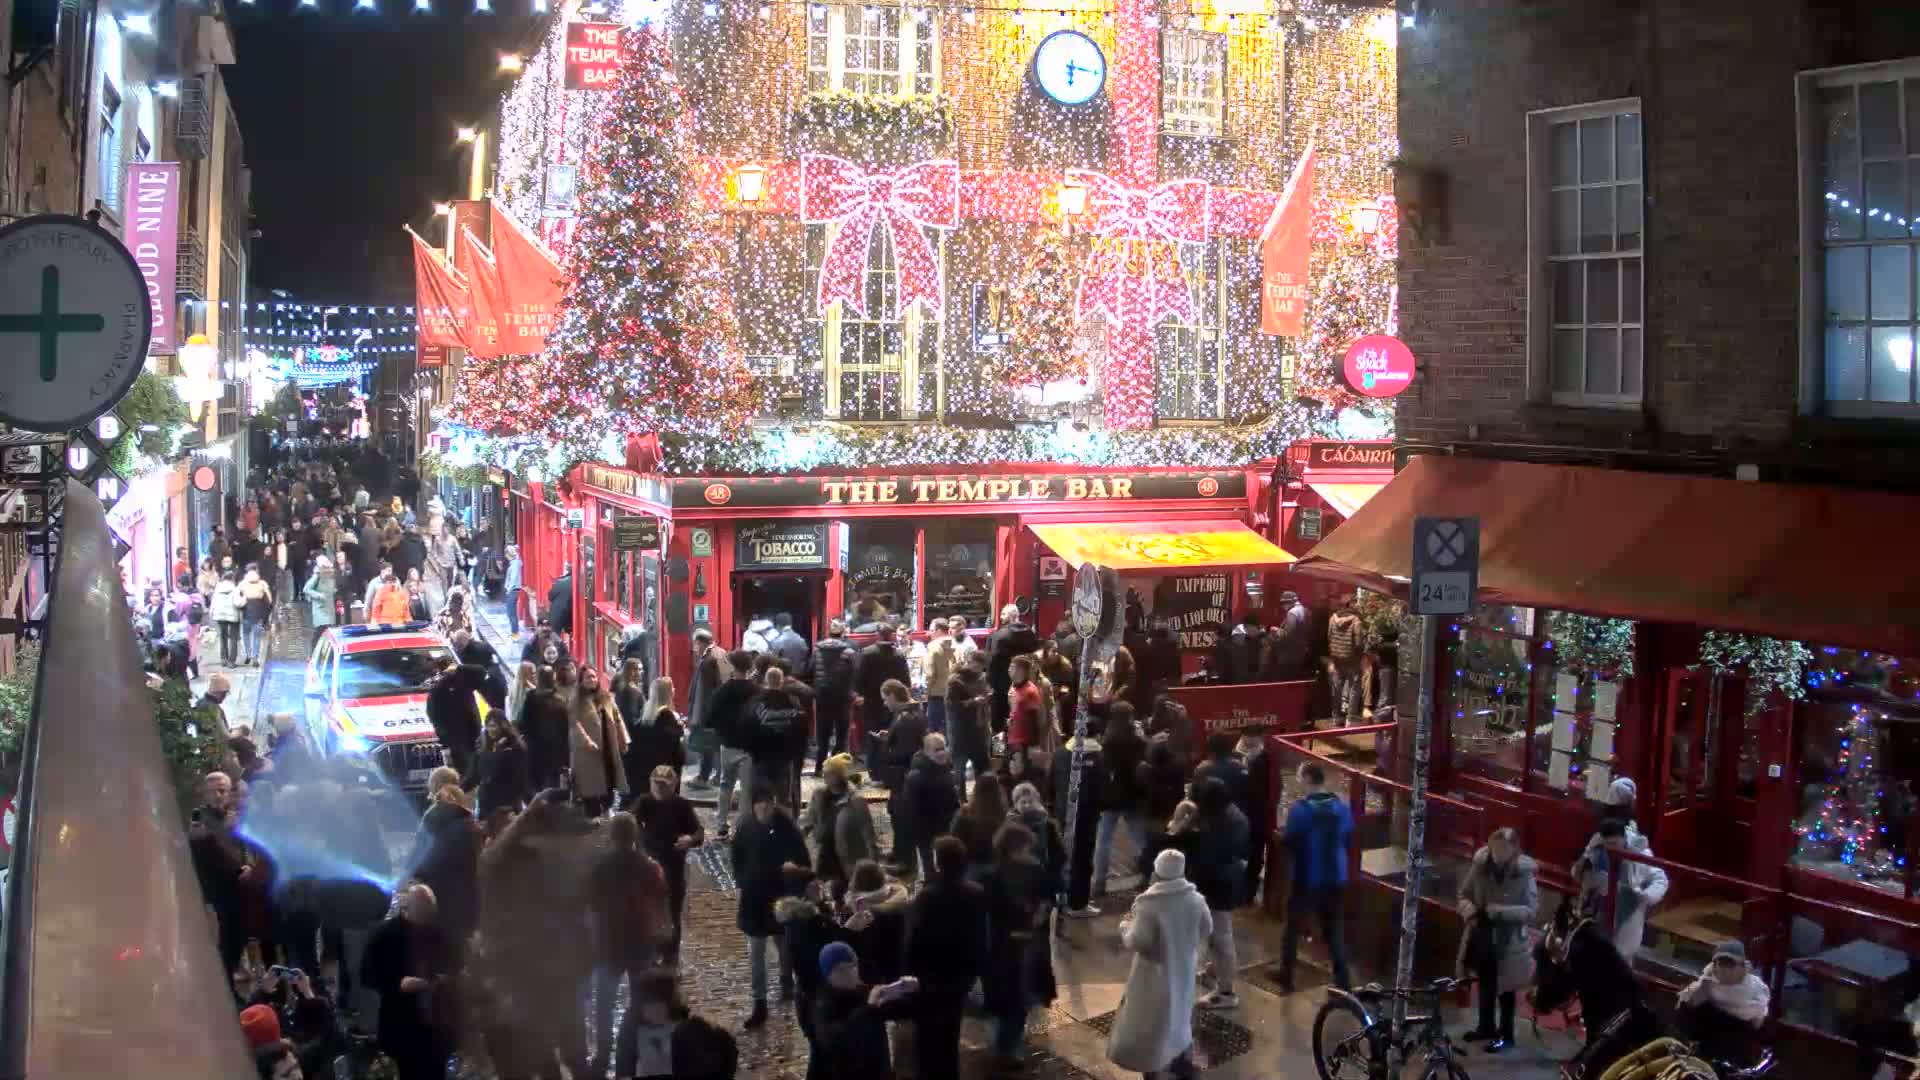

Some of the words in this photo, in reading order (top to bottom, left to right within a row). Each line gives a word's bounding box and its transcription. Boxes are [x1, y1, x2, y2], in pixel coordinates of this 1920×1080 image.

[584, 29, 618, 44] THE
[568, 47, 623, 63] TEMPL
[137, 171, 169, 232] NINE
[711, 488, 726, 499] 48
[823, 480, 899, 504] THE
[912, 478, 1049, 503] TEMPLE
[1065, 477, 1133, 500] BAR
[1200, 481, 1216, 493] 48
[749, 538, 816, 561] TOBACCO
[1176, 578, 1226, 593] EMPEROR
[1423, 584, 1443, 601] 24
[1212, 593, 1225, 607] OF
[1184, 608, 1227, 628] LIQUORS
[383, 717, 426, 727] GAR
